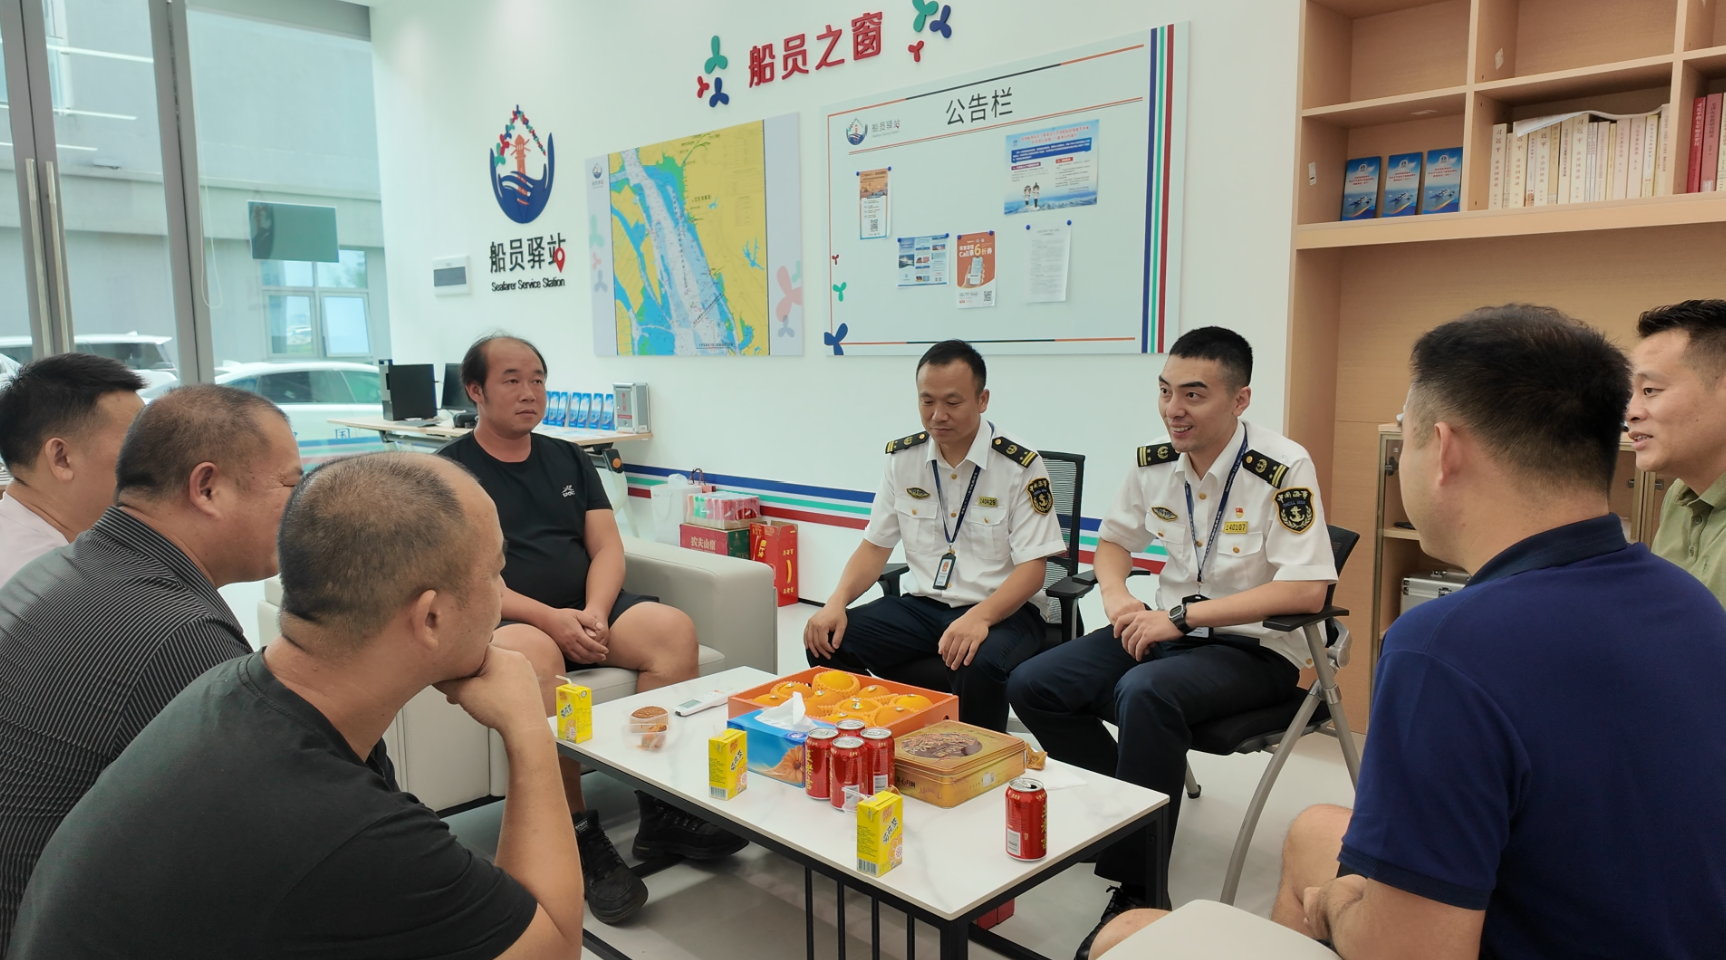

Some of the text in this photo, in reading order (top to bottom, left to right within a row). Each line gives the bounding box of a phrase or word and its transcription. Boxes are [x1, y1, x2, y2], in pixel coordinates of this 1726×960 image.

[749, 11, 883, 88] 船员之窗
[945, 87, 1013, 125] 公告栏
[489, 232, 567, 274] 船员驿站
[517, 278, 542, 291] Service
[542, 276, 566, 289] Station
[1225, 523, 1246, 531] 140107
